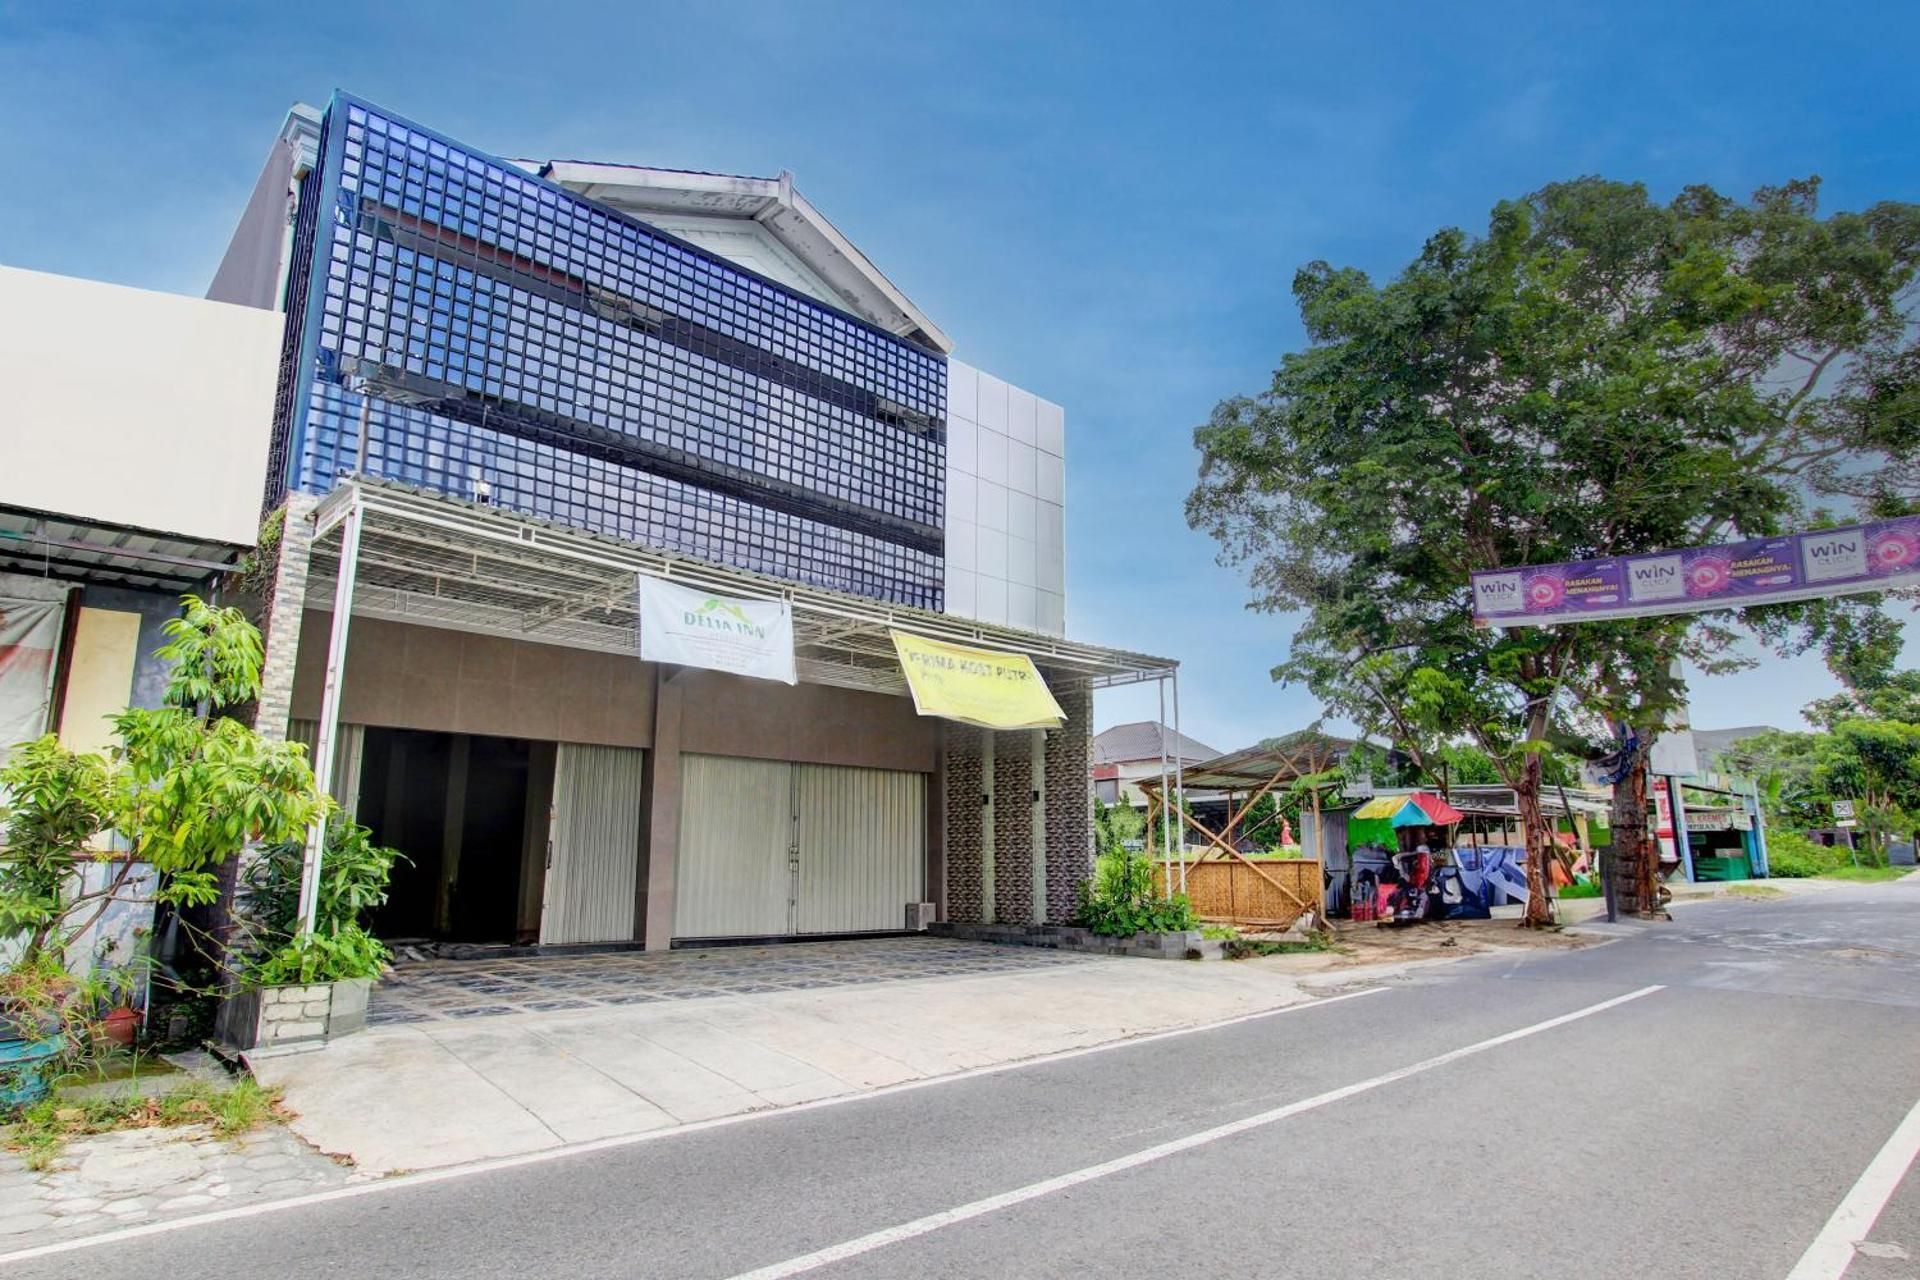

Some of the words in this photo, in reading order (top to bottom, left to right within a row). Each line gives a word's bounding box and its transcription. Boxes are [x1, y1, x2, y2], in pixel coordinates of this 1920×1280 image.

[1811, 541, 1856, 558] WIN
[1635, 564, 1675, 580] WIN
[1480, 580, 1517, 594] WIN
